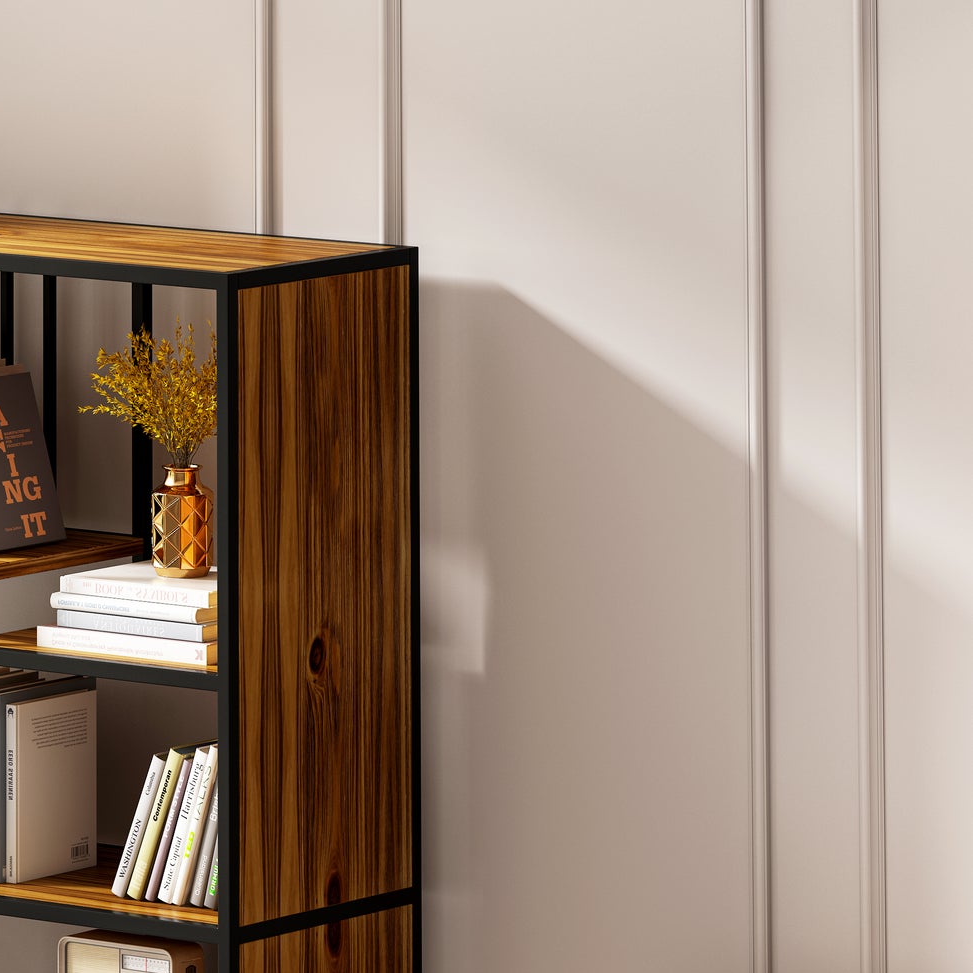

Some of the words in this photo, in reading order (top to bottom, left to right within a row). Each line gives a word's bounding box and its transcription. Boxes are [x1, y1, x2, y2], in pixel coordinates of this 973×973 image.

[118, 818, 142, 878] WASHINGTON
[163, 867, 174, 890] State
[169, 835, 183, 867] Capital
[180, 761, 204, 820] Harrisburg
